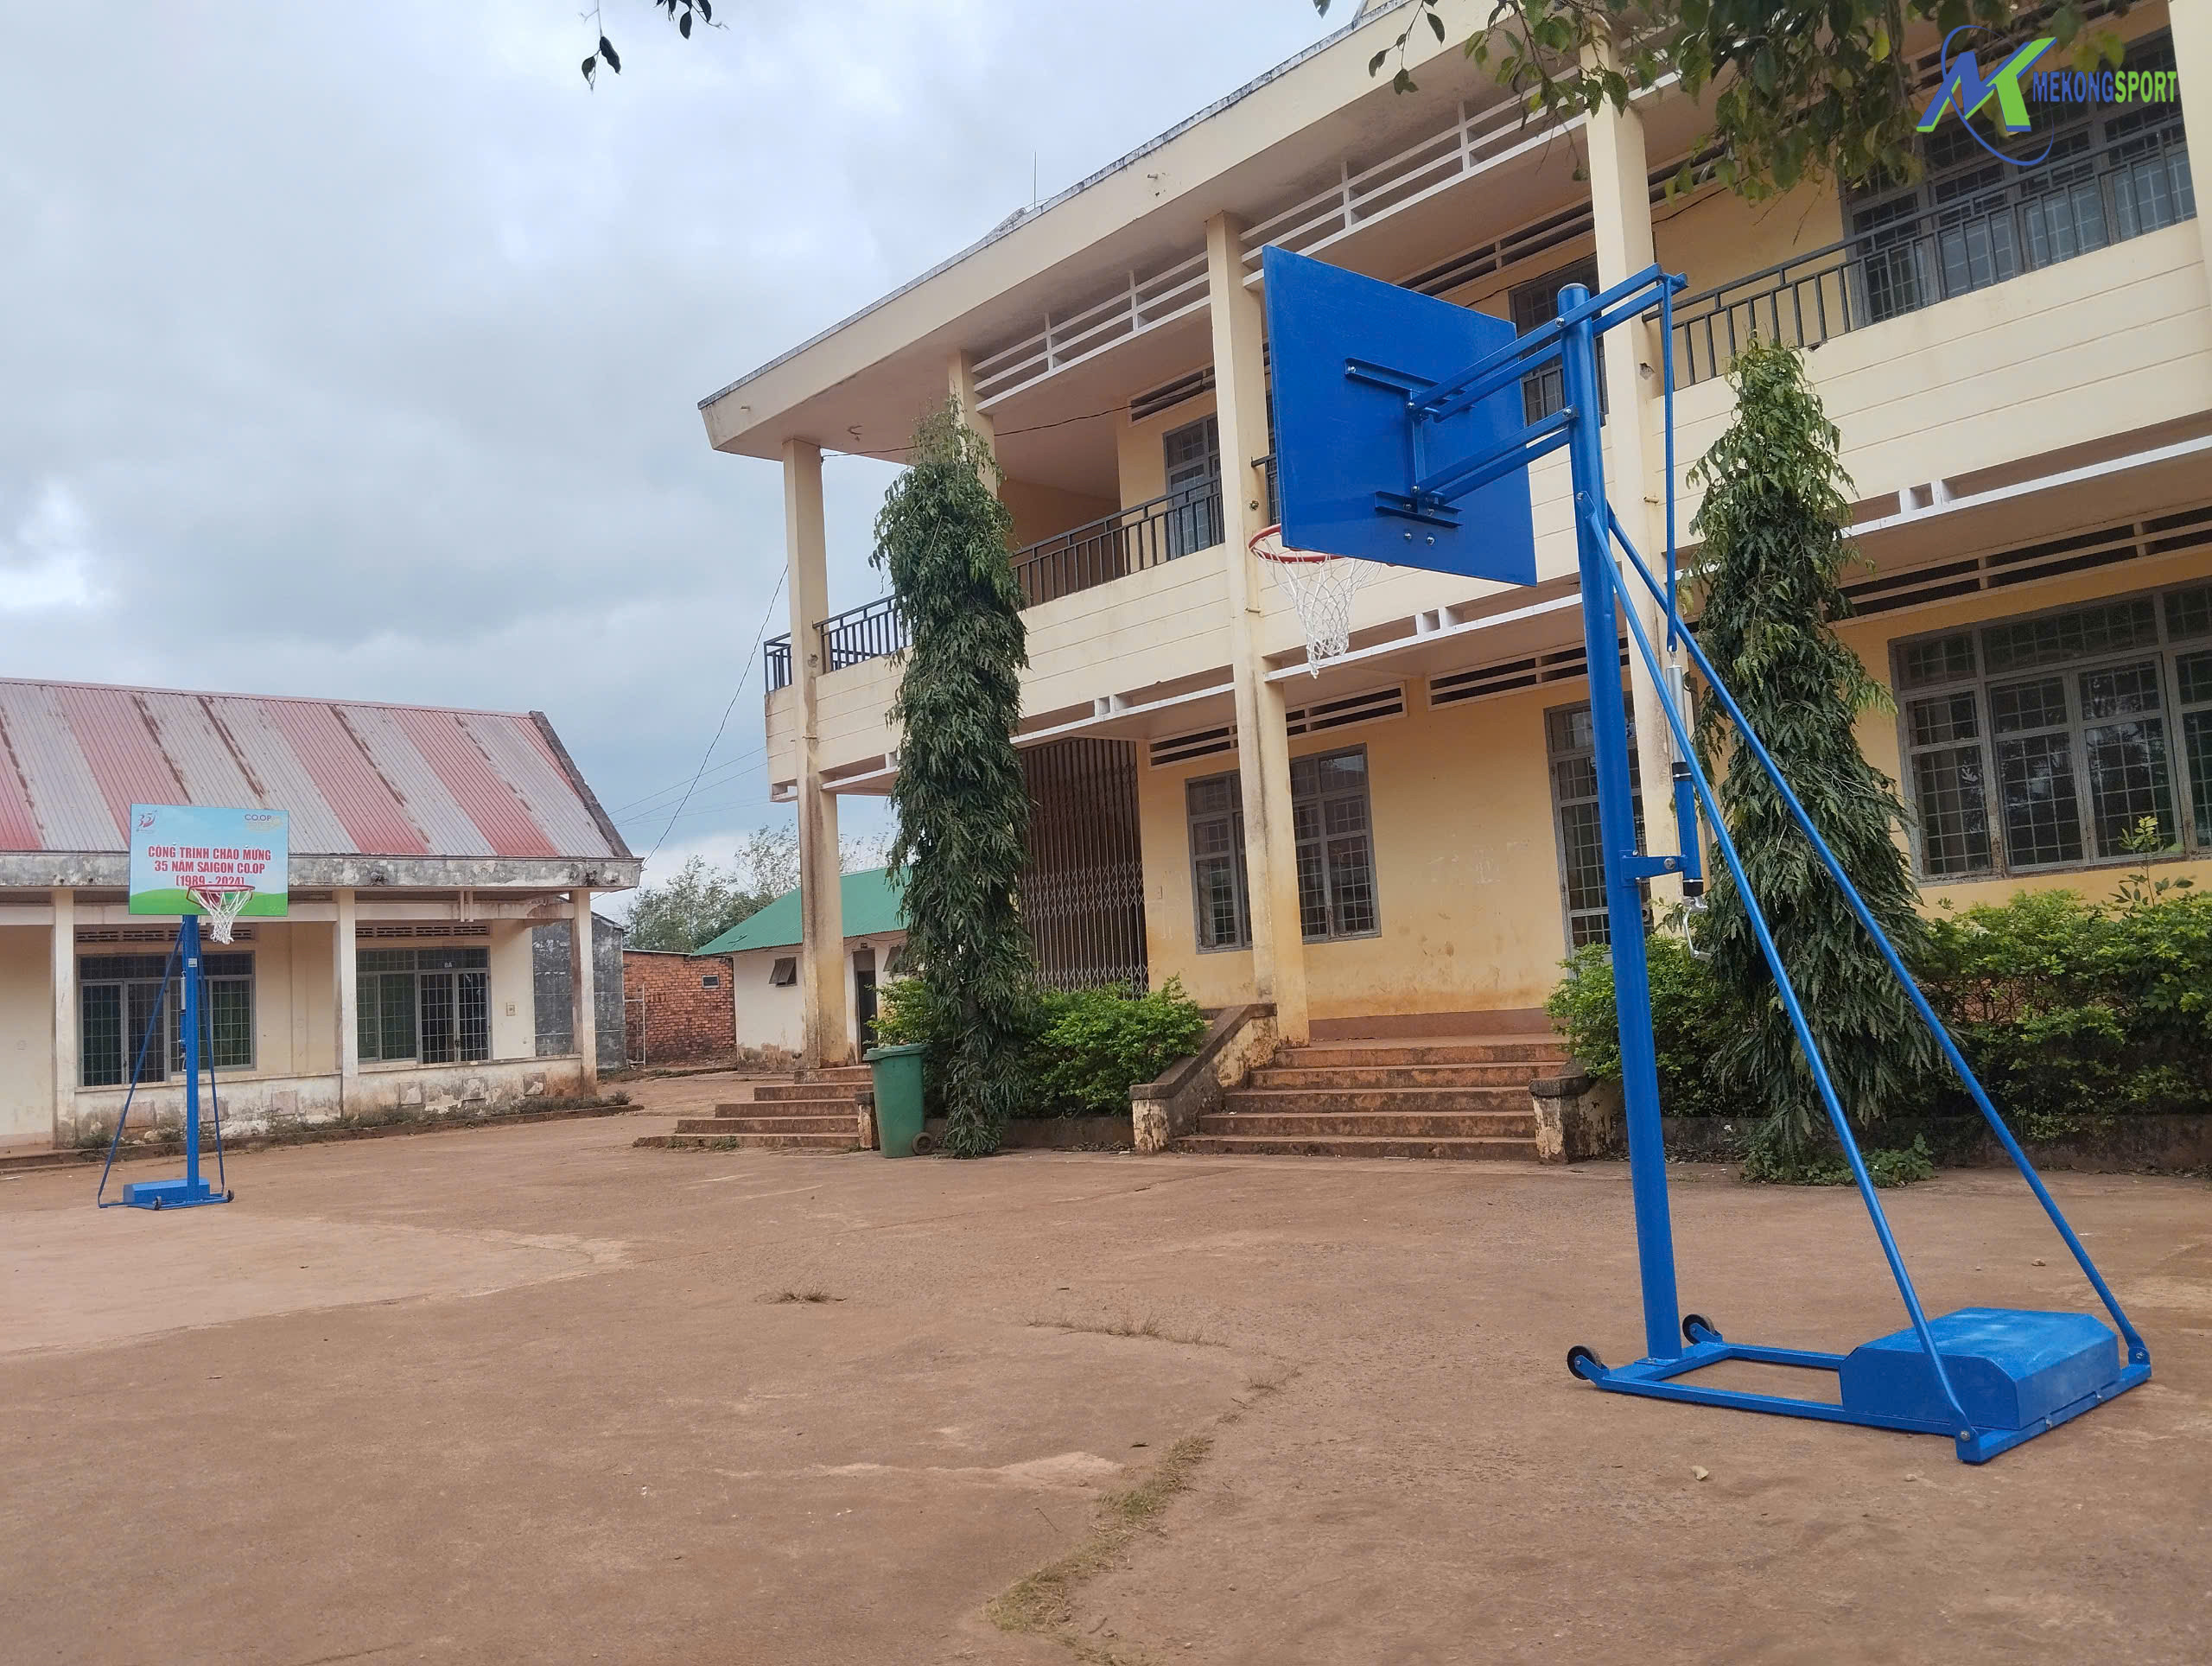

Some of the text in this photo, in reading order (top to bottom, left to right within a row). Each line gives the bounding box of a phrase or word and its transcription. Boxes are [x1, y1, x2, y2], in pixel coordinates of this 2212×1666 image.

[155, 861, 168, 872] 35
[197, 862, 234, 874] SAIGON
[237, 862, 265, 874] CO.OP
